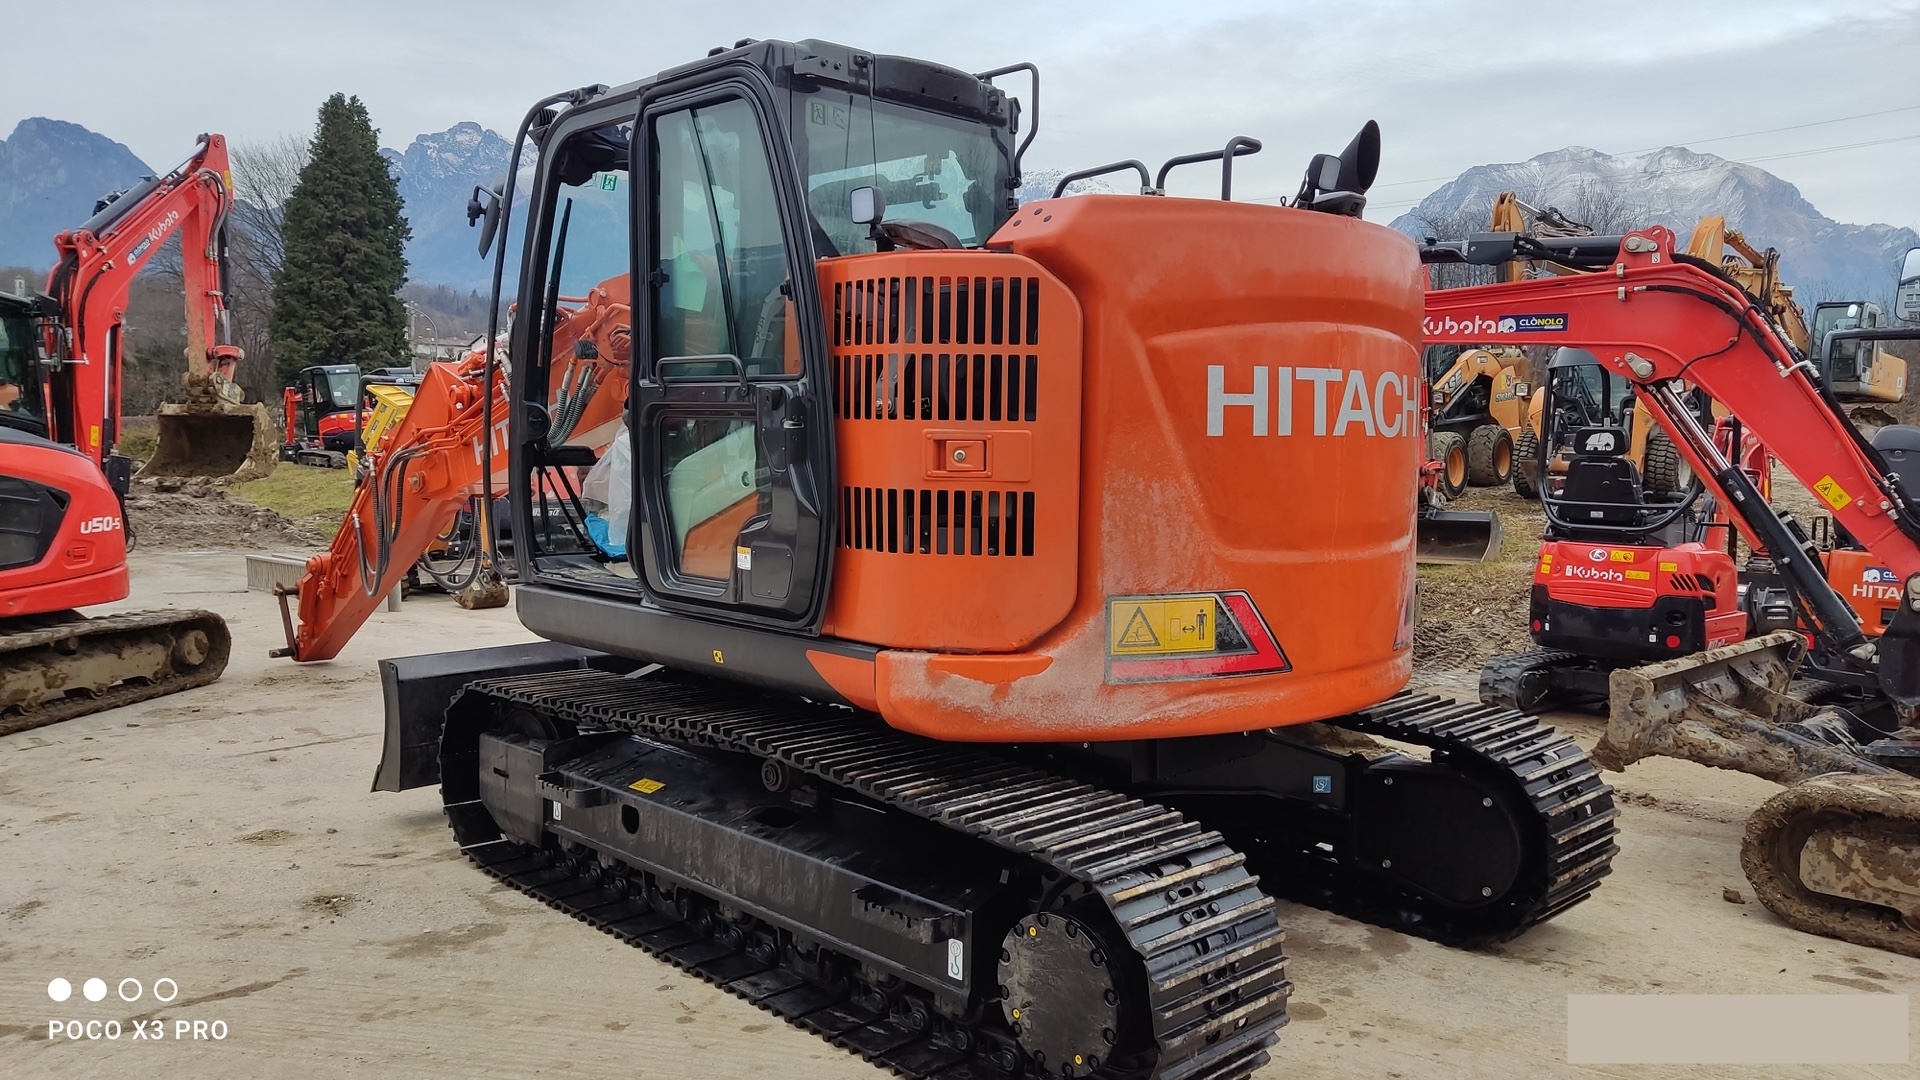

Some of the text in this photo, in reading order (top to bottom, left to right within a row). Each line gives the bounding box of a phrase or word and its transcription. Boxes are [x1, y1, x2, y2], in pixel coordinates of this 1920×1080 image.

[148, 210, 179, 241] Kubota
[1443, 369, 1462, 394] ASE
[472, 417, 510, 466] HIT
[1574, 565, 1623, 582] Kubota
